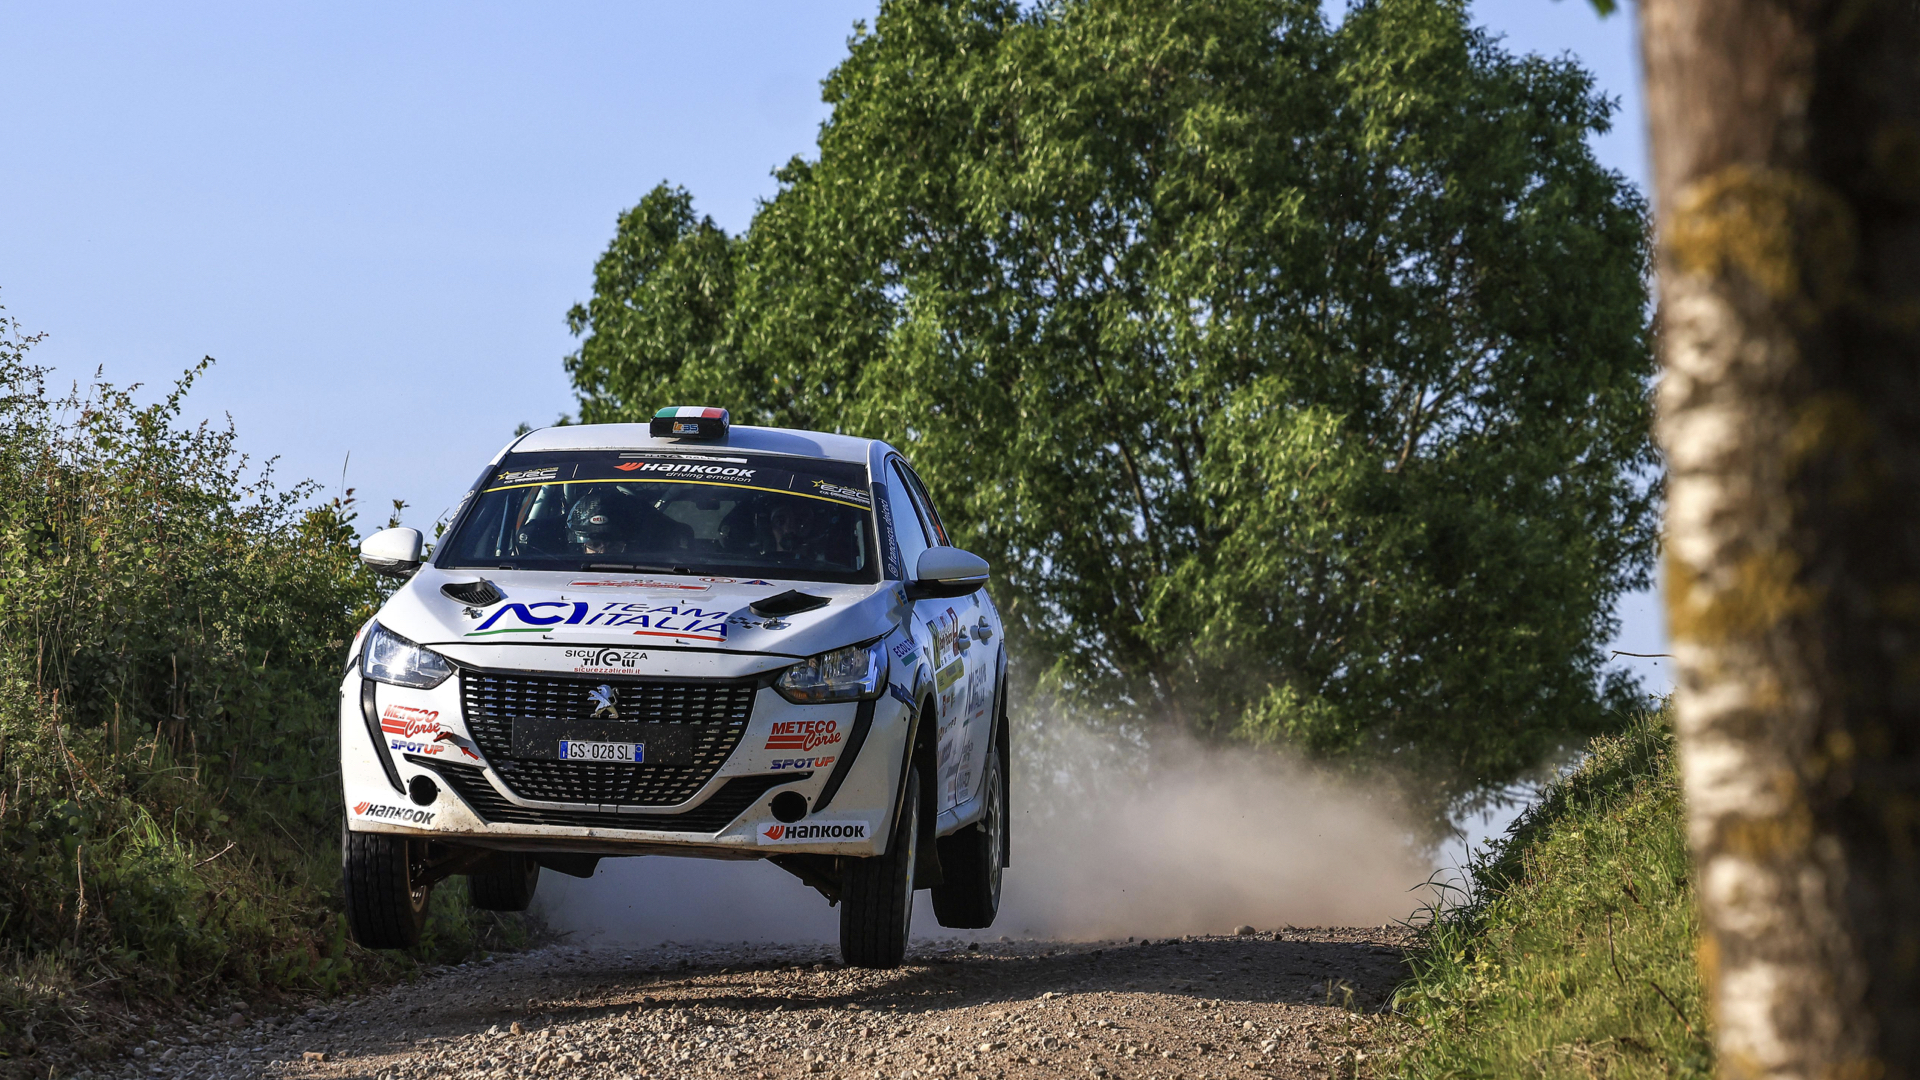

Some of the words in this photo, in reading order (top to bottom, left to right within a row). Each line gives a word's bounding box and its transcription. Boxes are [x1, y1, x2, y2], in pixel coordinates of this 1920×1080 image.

[665, 471, 704, 480] driving
[705, 474, 752, 483] emotion
[474, 601, 589, 631] ACI
[599, 602, 729, 619] TEAM
[586, 613, 728, 637] ITALIA
[384, 704, 439, 722] METECO
[405, 720, 441, 738] Corse
[771, 720, 837, 735] METECO
[803, 731, 842, 752] Corse
